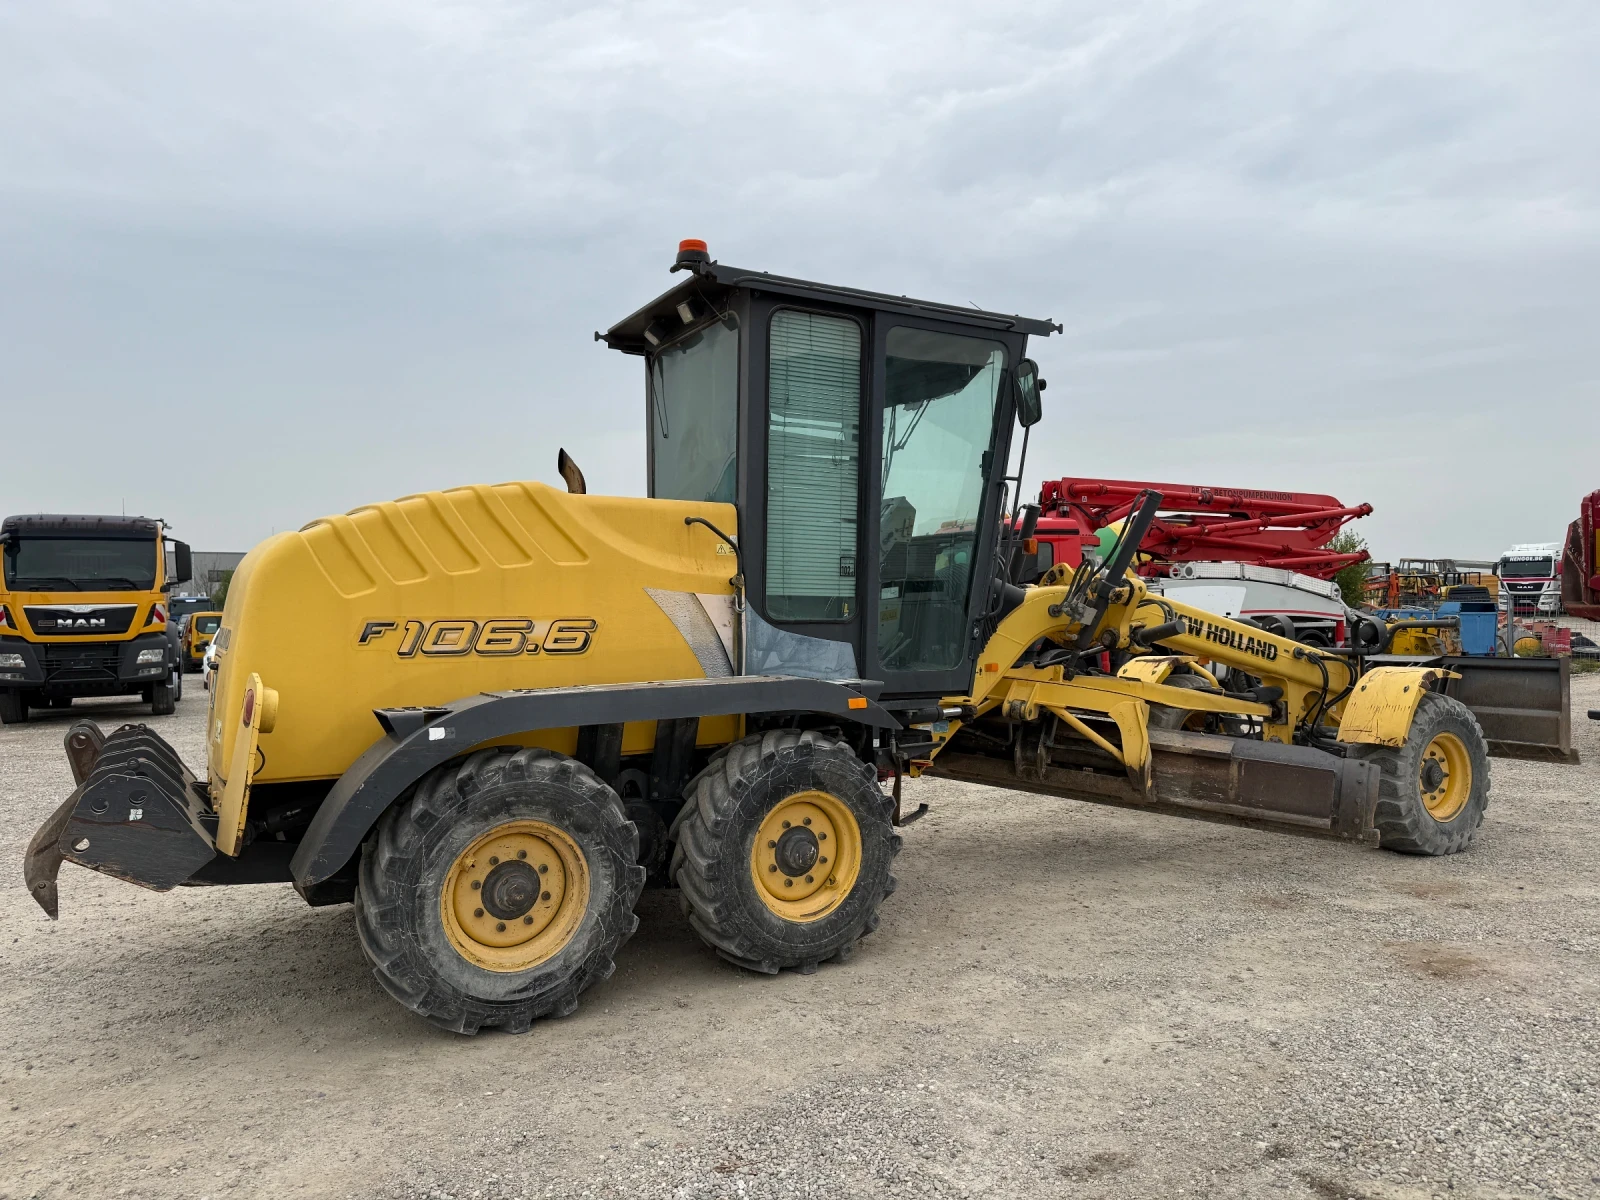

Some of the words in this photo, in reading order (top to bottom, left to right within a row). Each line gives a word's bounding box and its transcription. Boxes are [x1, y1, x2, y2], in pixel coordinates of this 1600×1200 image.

[1214, 488, 1292, 501] BETONPUMPENUNION
[57, 618, 105, 628] MAN
[358, 621, 398, 645] F
[397, 619, 597, 657] 106.6
[1206, 622, 1278, 661] HOLLAND
